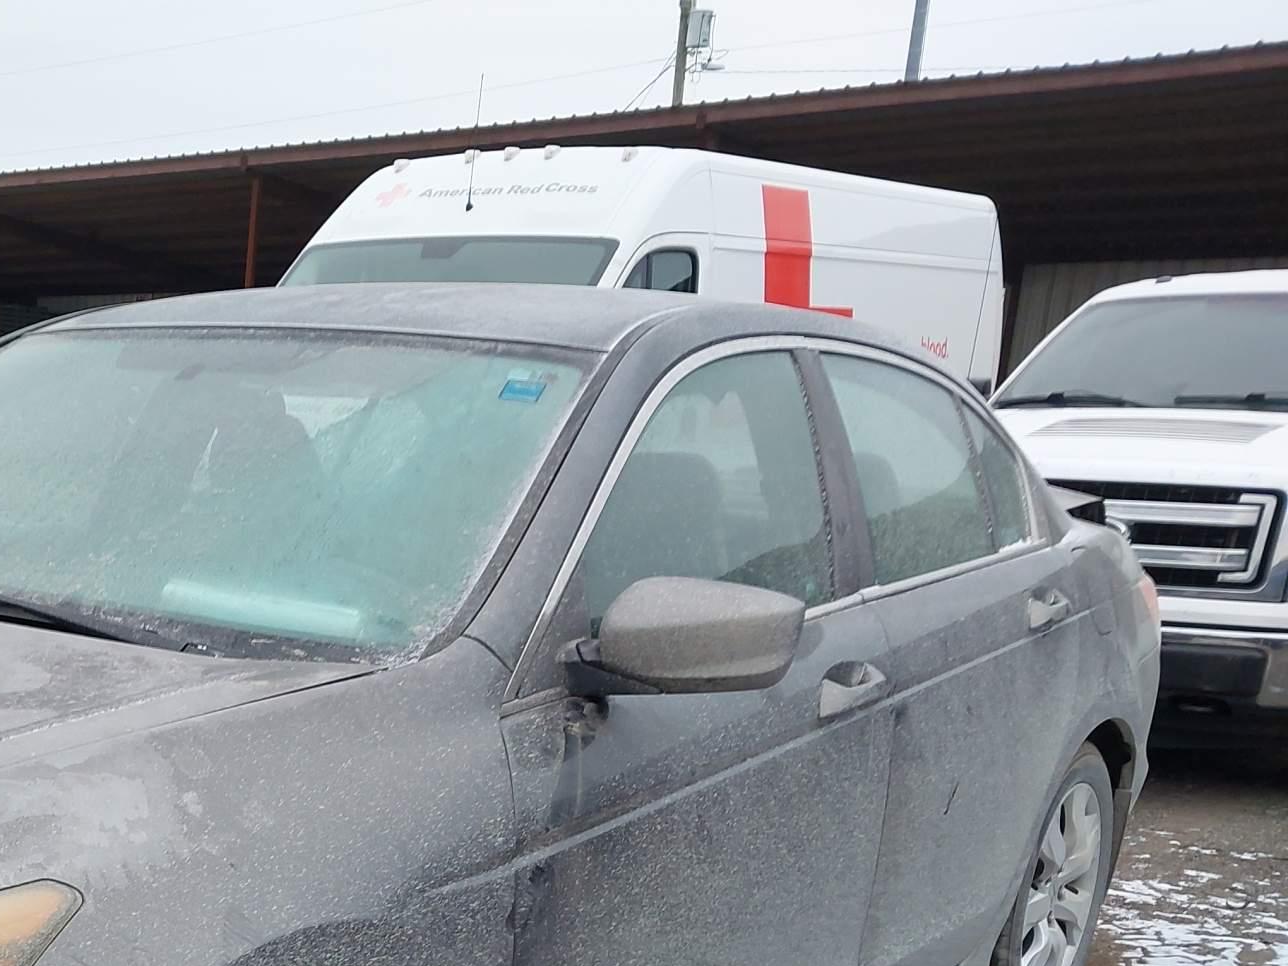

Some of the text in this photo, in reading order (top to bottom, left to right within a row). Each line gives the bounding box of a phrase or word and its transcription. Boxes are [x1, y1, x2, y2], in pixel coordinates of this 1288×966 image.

[418, 182, 600, 198] American Red Cross
